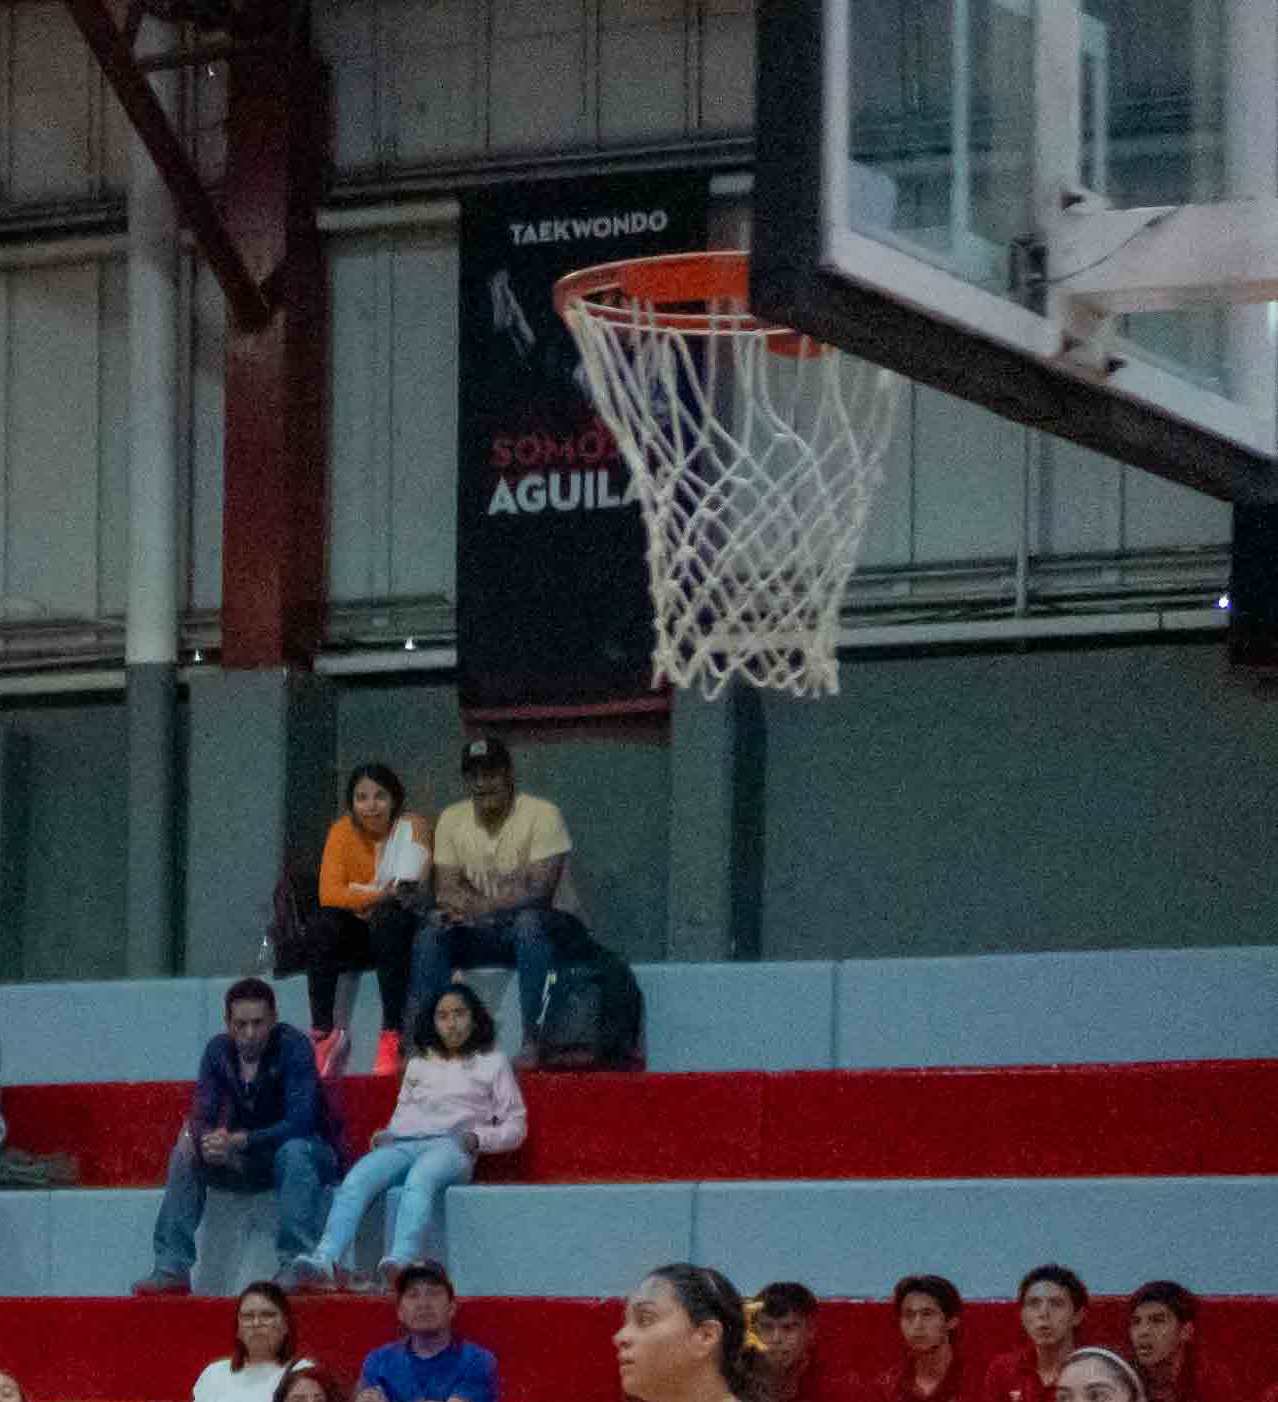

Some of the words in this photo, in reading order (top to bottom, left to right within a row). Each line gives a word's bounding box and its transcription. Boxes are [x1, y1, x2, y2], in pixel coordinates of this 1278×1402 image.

[509, 210, 669, 245] TAEKWONDO
[491, 424, 619, 468] SOMO
[488, 470, 647, 515] AGUILA
